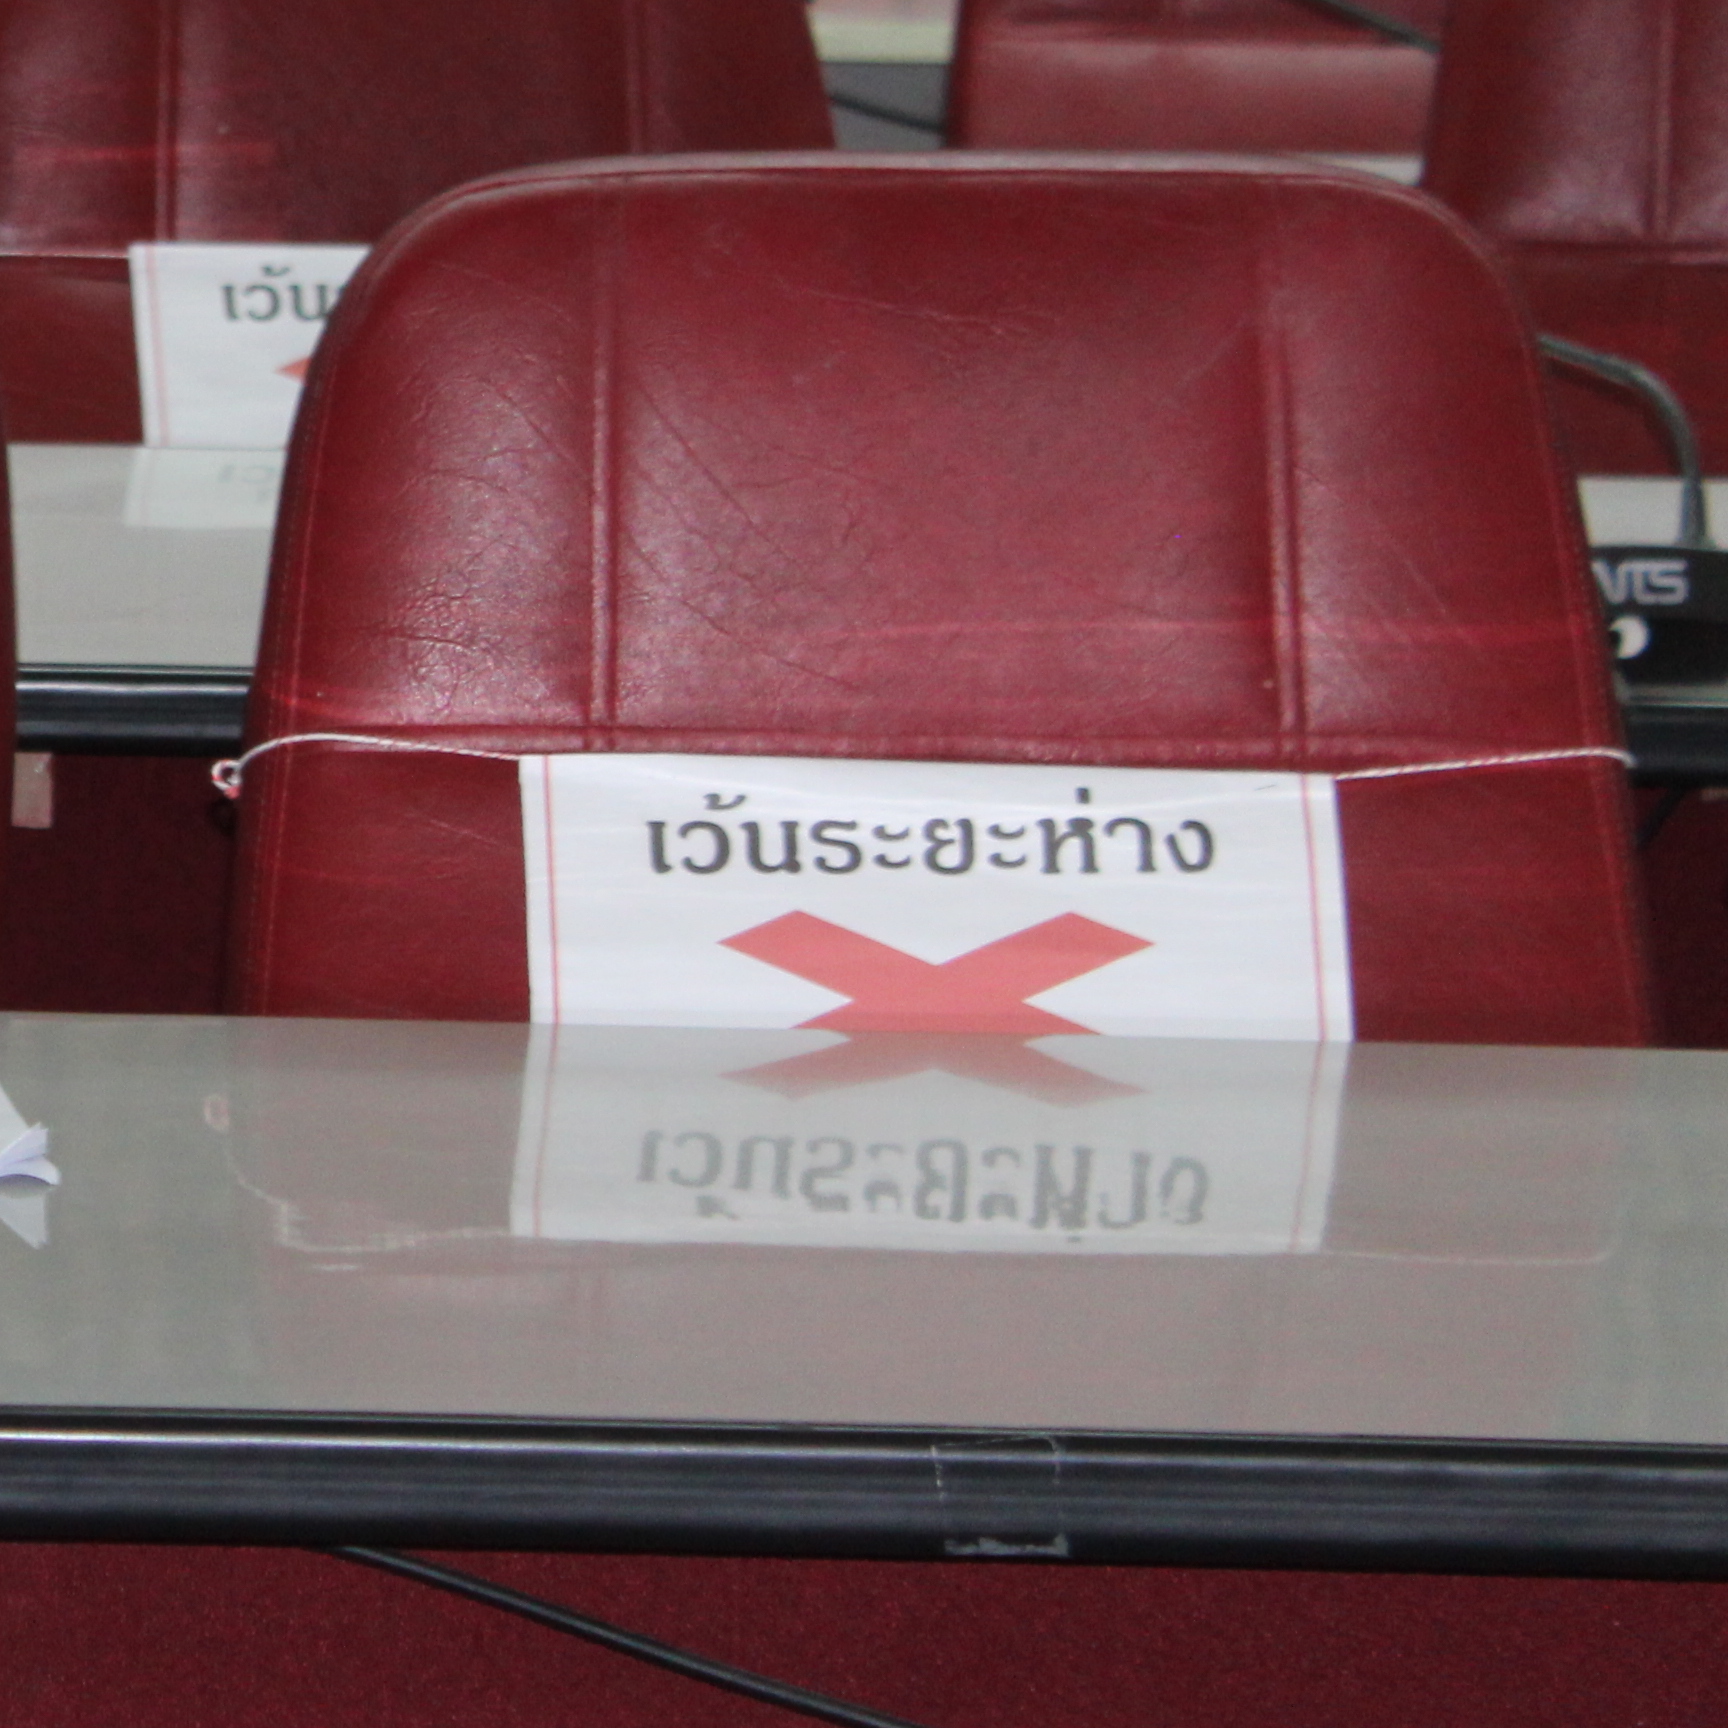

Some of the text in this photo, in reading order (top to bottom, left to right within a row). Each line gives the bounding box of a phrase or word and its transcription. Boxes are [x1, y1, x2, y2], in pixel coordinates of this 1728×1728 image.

[221, 265, 346, 322] เว้น
[646, 787, 1215, 875] เว้นระยะห่าง
